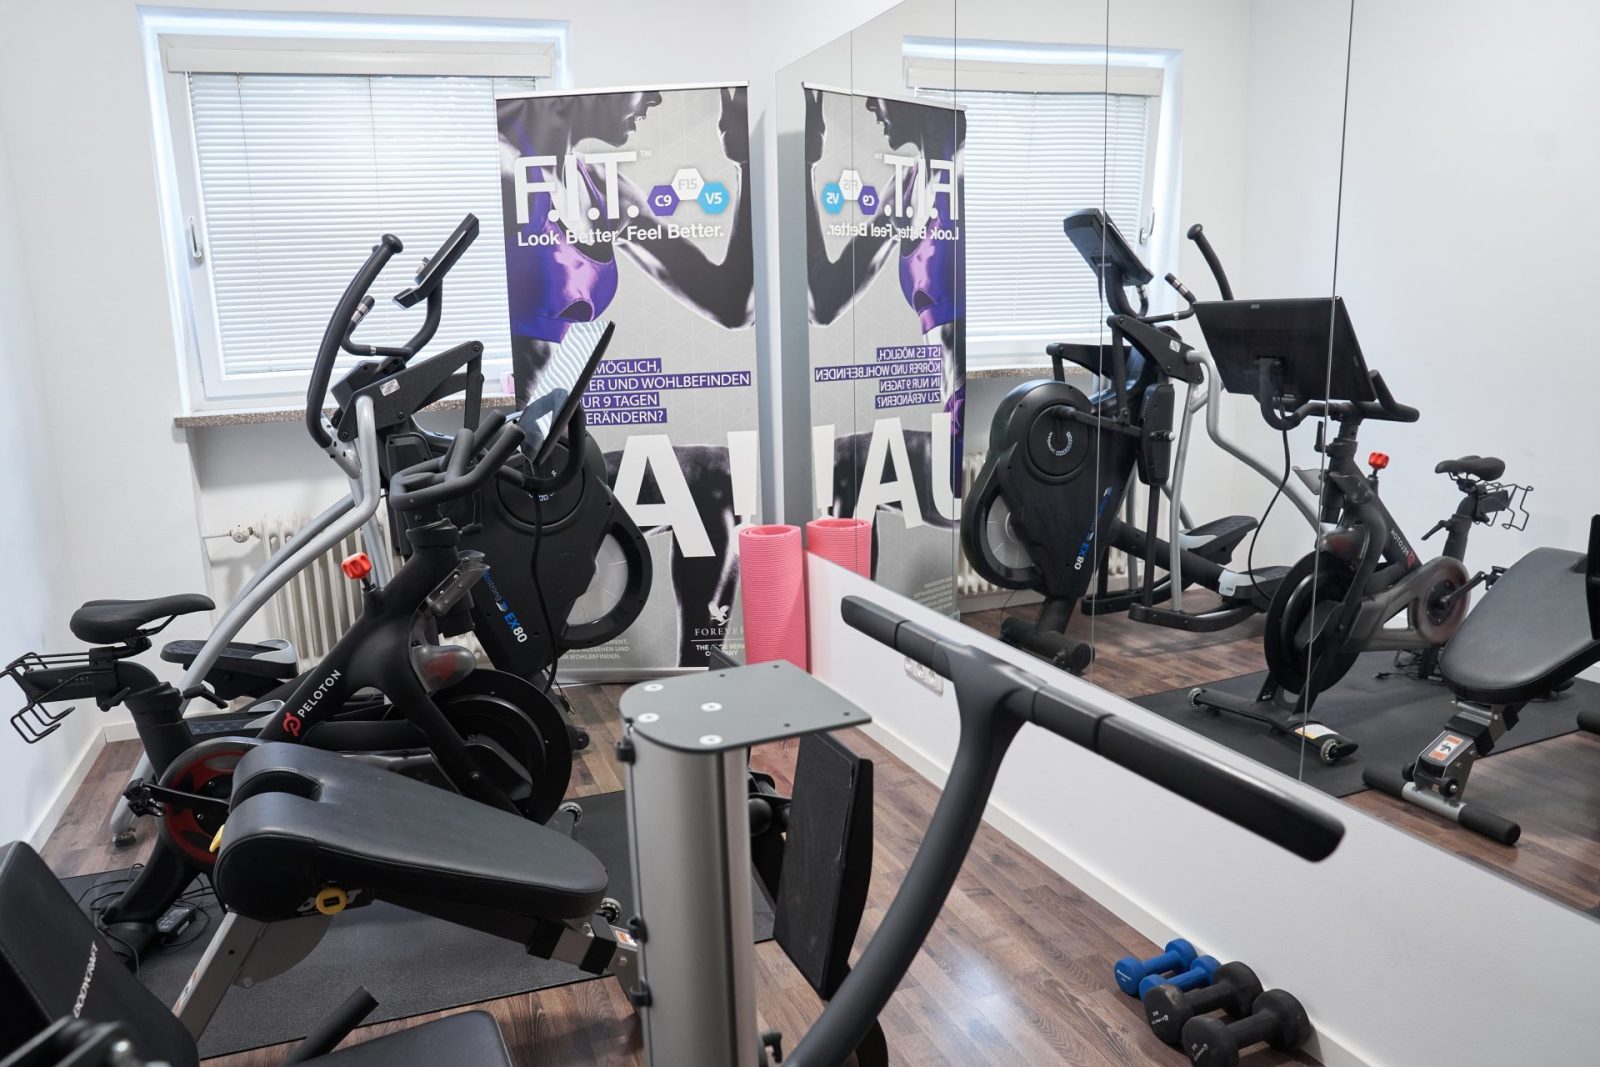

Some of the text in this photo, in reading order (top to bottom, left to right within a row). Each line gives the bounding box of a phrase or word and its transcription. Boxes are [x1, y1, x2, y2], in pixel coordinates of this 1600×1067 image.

[513, 151, 640, 225] F.I.T.
[677, 178, 698, 190] F15
[654, 194, 673, 207] C9
[705, 191, 723, 206] V5
[517, 223, 725, 247] Look Better. Feel Better.
[608, 378, 639, 391] UND
[641, 373, 750, 390] WOHLBEFINDEN
[579, 394, 658, 409] UR 9 TAGEN
[586, 410, 664, 425] ERÄNDERN?
[612, 430, 758, 558] A!
[504, 612, 528, 643] EX80
[297, 669, 343, 719] PELOTON
